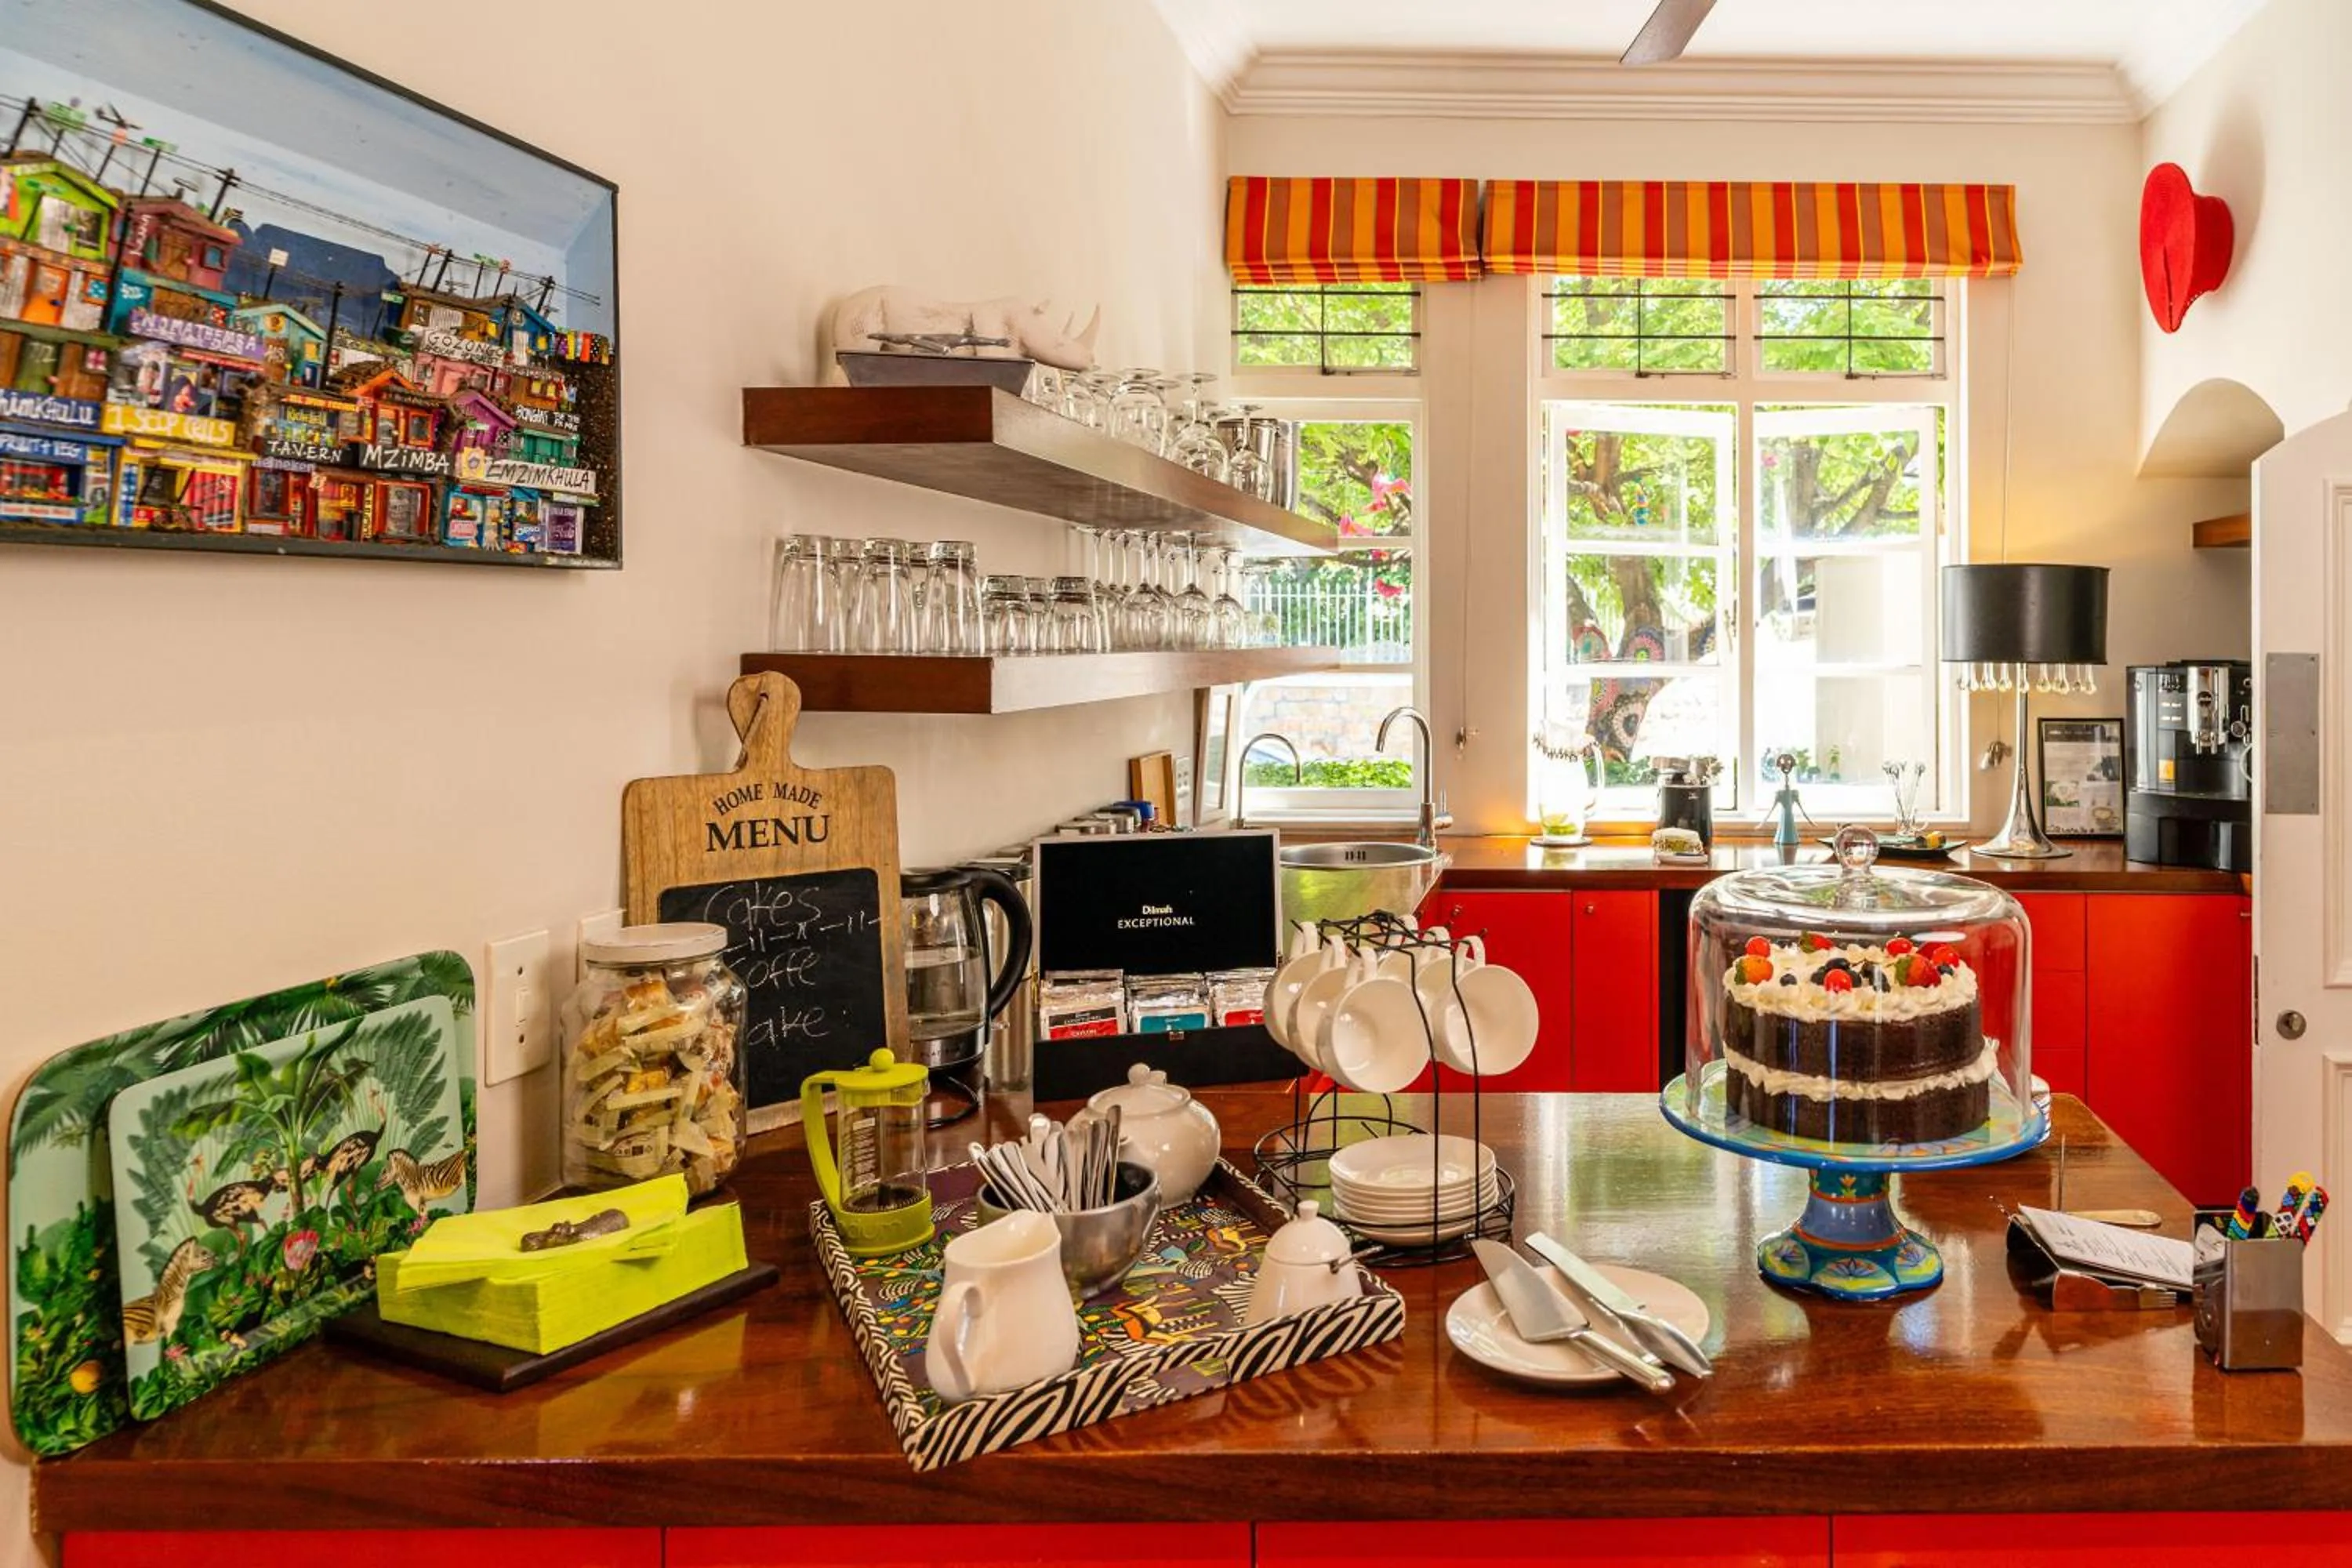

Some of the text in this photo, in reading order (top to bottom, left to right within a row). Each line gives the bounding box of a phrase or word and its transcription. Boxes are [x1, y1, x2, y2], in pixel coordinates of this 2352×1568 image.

[713, 782, 822, 816] HOME MADE
[706, 815, 830, 852] MENU
[704, 881, 822, 931] Cakes
[1117, 916, 1195, 929] EXCEPTIONAL
[728, 946, 822, 989] offe
[746, 1006, 831, 1047] ake
